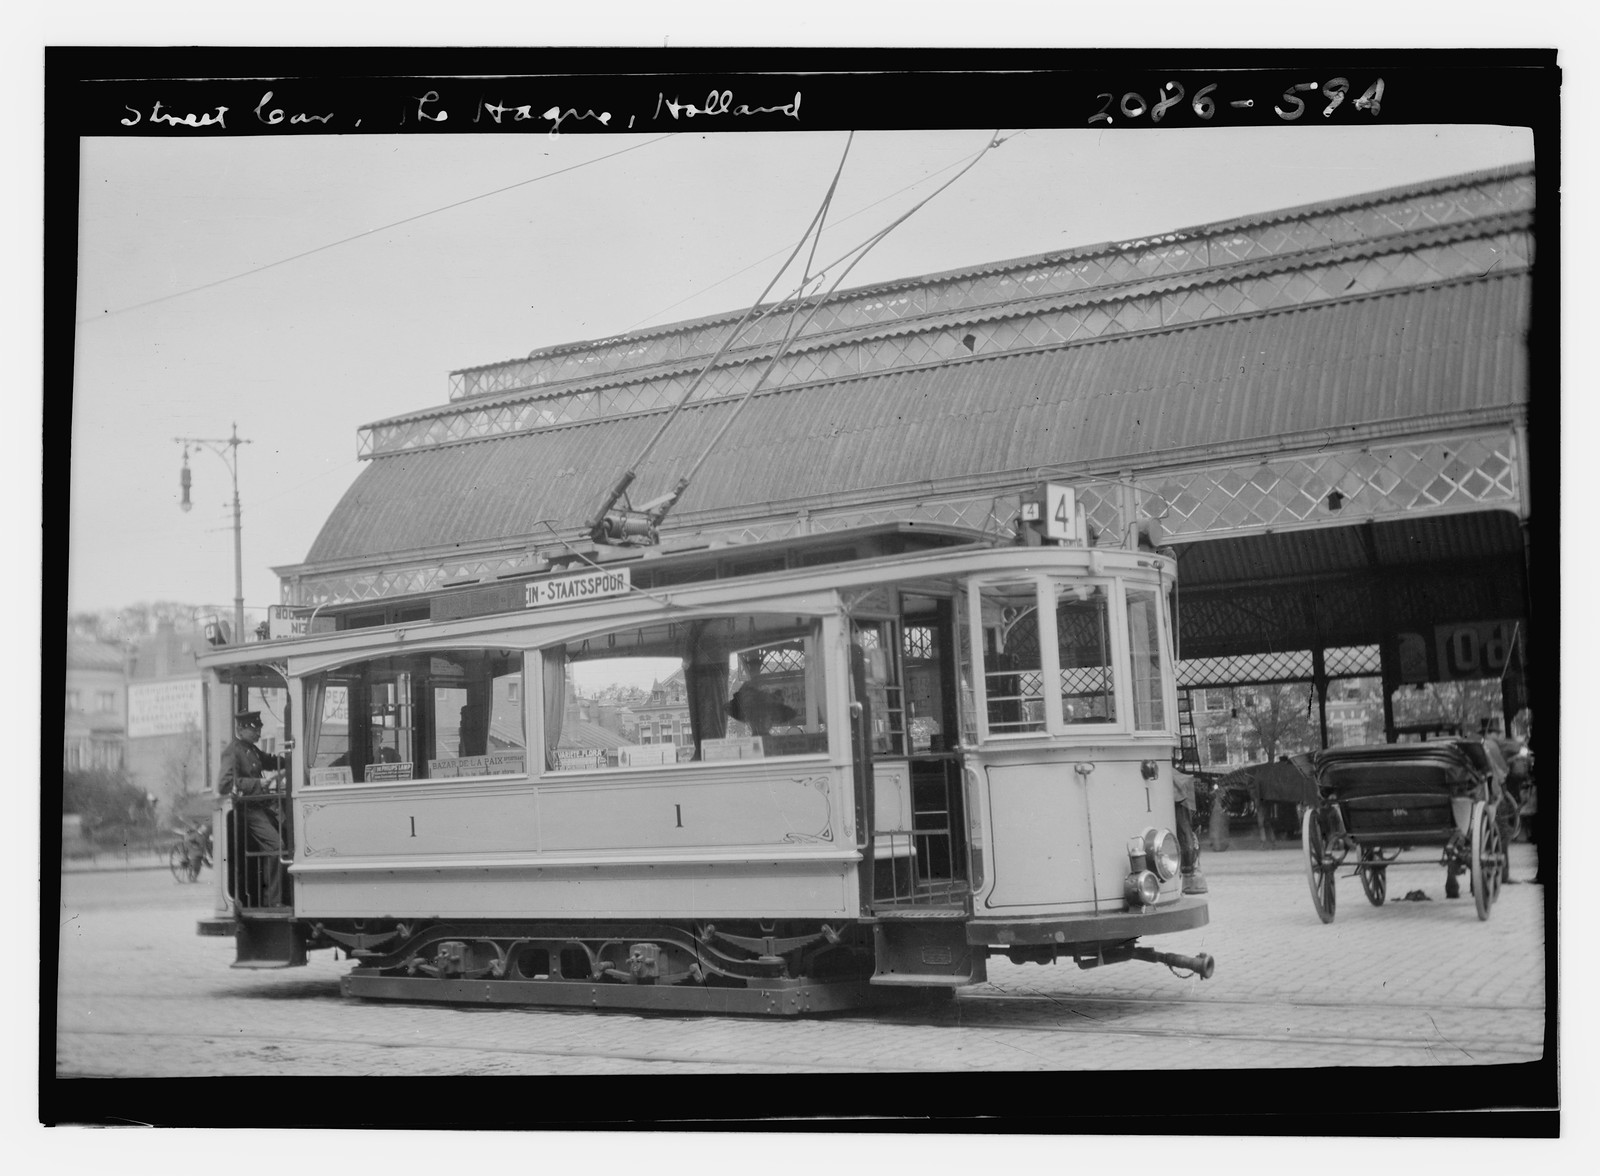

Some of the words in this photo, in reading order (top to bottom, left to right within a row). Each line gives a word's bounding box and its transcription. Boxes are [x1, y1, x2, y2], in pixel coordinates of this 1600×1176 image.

[120, 100, 230, 128] Street
[400, 90, 449, 126] The
[652, 89, 802, 121] Holland
[1026, 503, 1035, 518] 4
[1055, 493, 1069, 533] 4
[547, 573, 624, 600] STAATSSPOOR
[432, 760, 457, 770] BAZAR
[459, 760, 468, 768] DE
[470, 759, 482, 767] LA
[484, 757, 504, 766] PAIX
[409, 816, 417, 838] 1
[674, 804, 684, 828] 1
